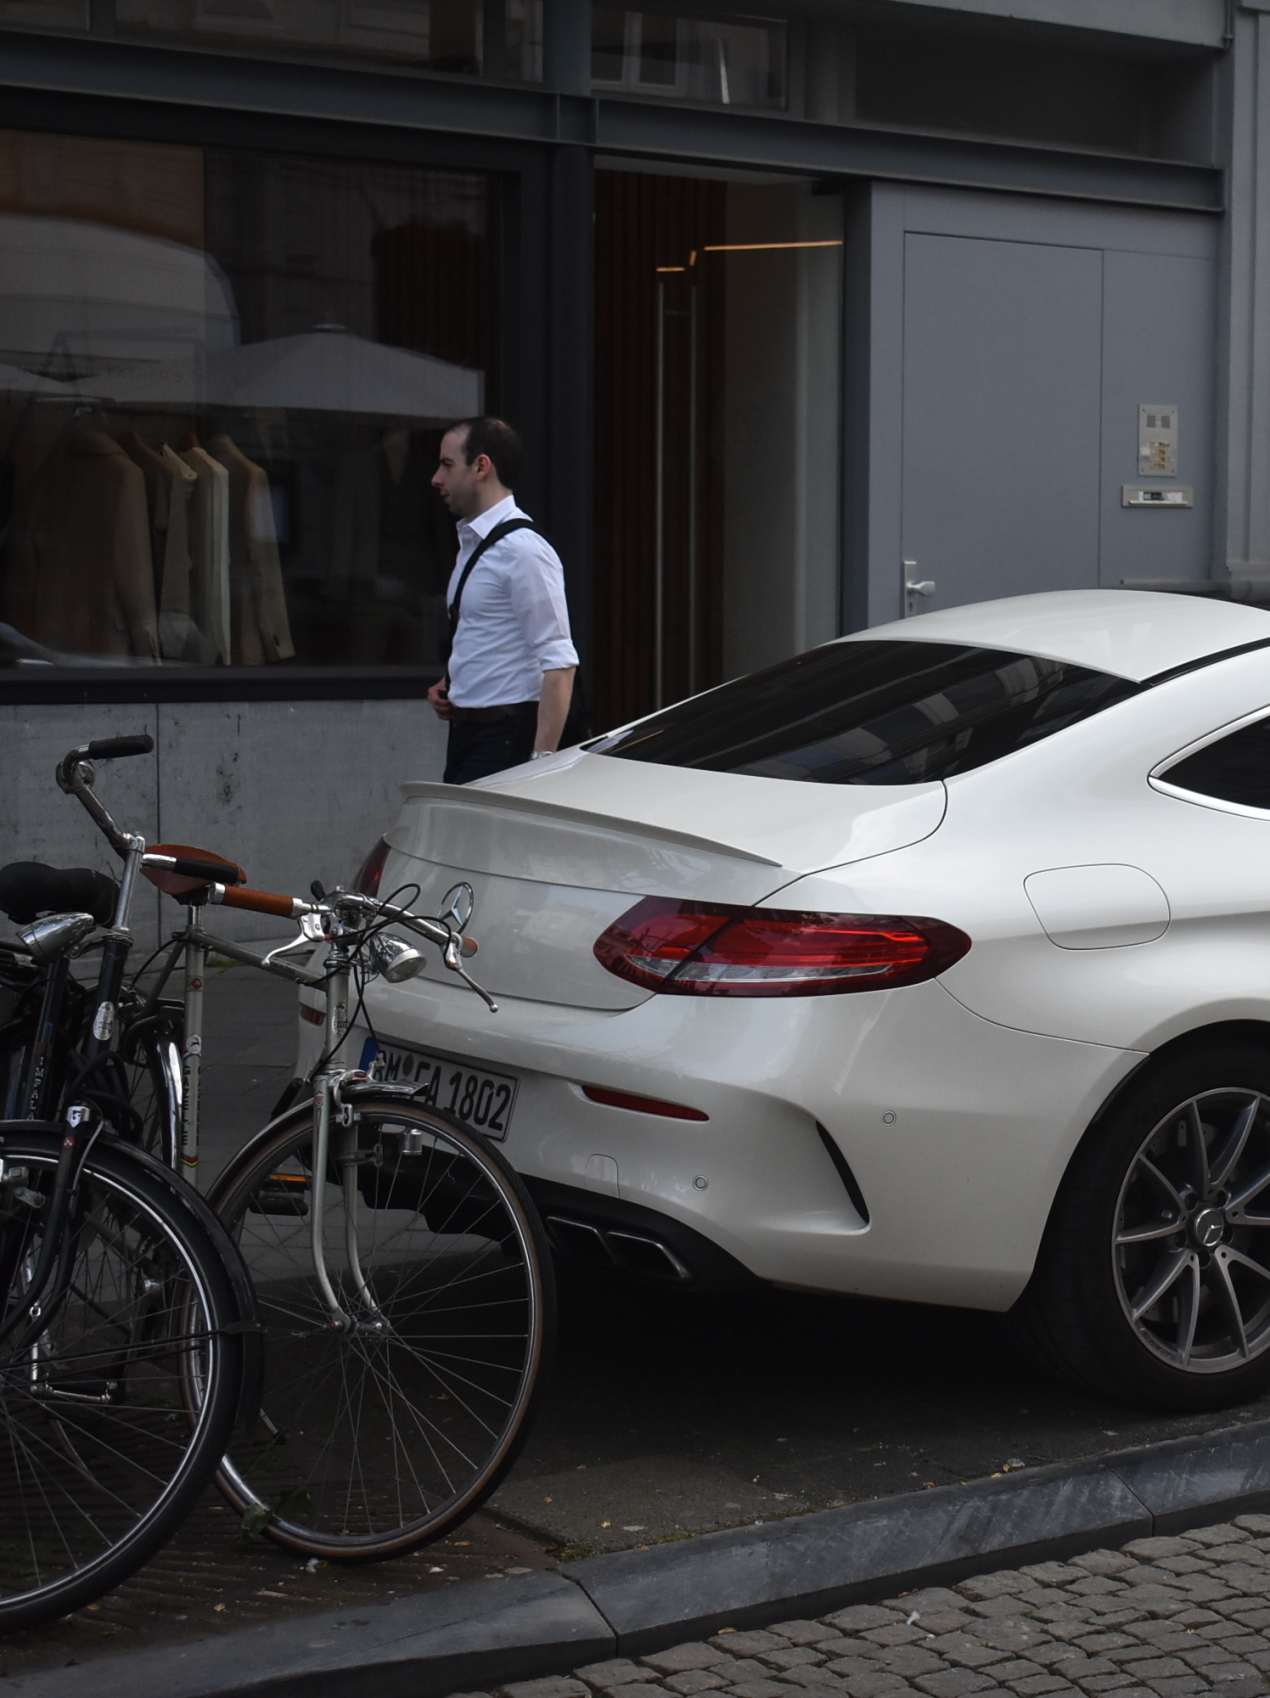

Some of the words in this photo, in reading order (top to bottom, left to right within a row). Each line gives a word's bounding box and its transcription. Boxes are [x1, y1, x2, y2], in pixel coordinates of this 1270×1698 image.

[27, 1056, 45, 1121] IMPALA
[181, 1065, 191, 1146] GAZELLE
[443, 1071, 511, 1131] 1802
